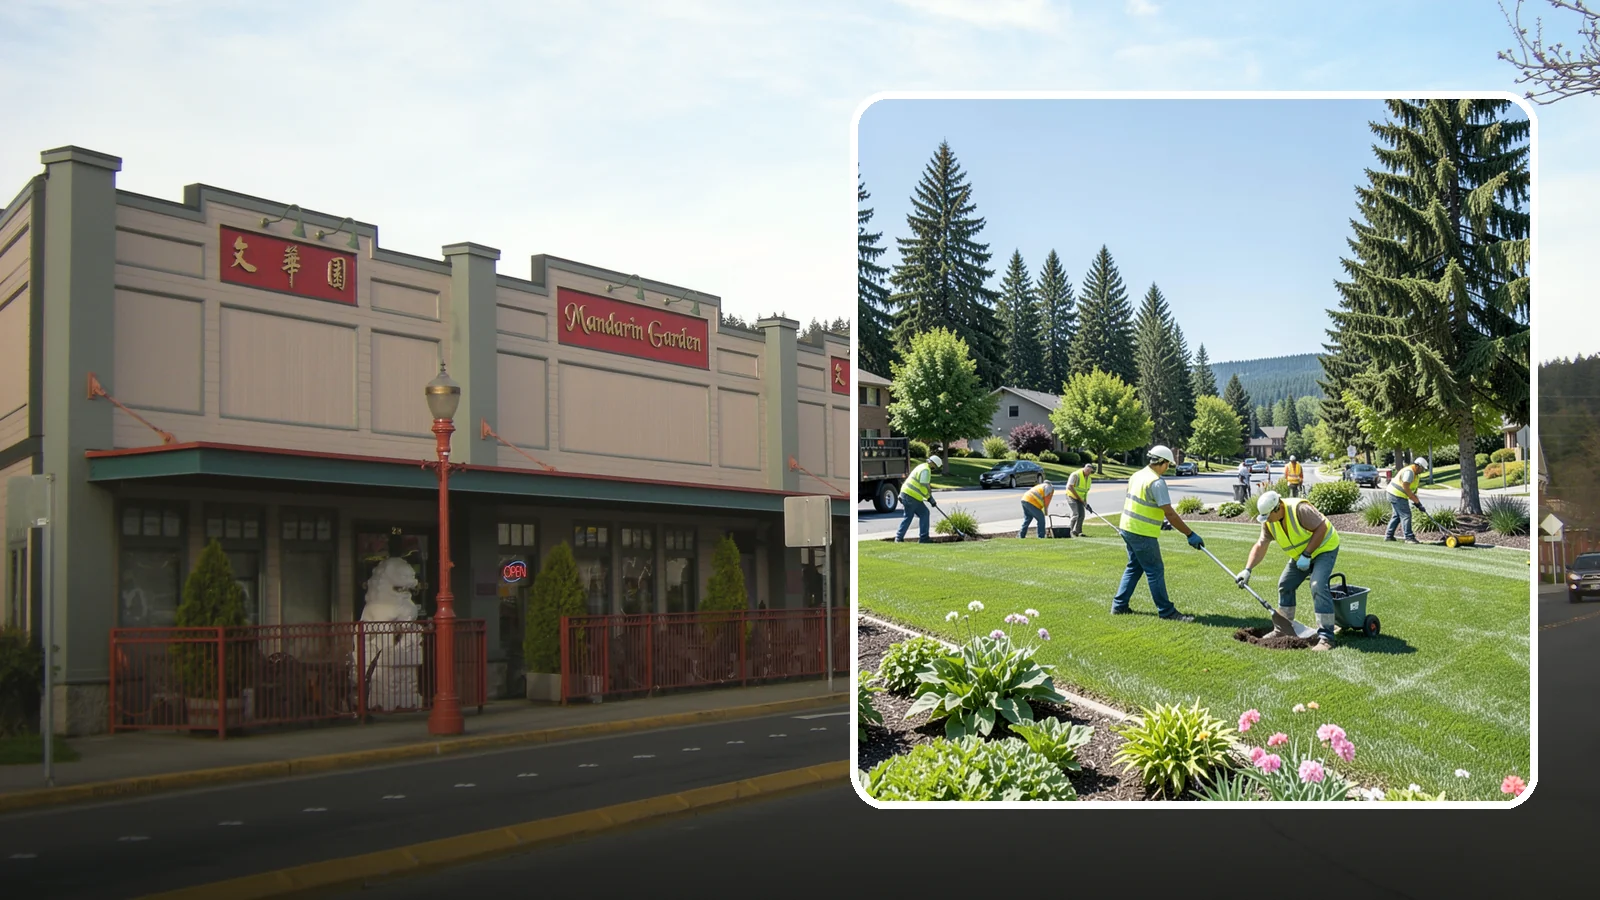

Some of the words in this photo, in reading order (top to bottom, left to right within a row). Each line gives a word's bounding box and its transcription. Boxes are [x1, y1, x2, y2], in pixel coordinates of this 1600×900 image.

[564, 302, 644, 341] Mandarin
[648, 320, 701, 352] Garden
[503, 565, 527, 578] OPEN
